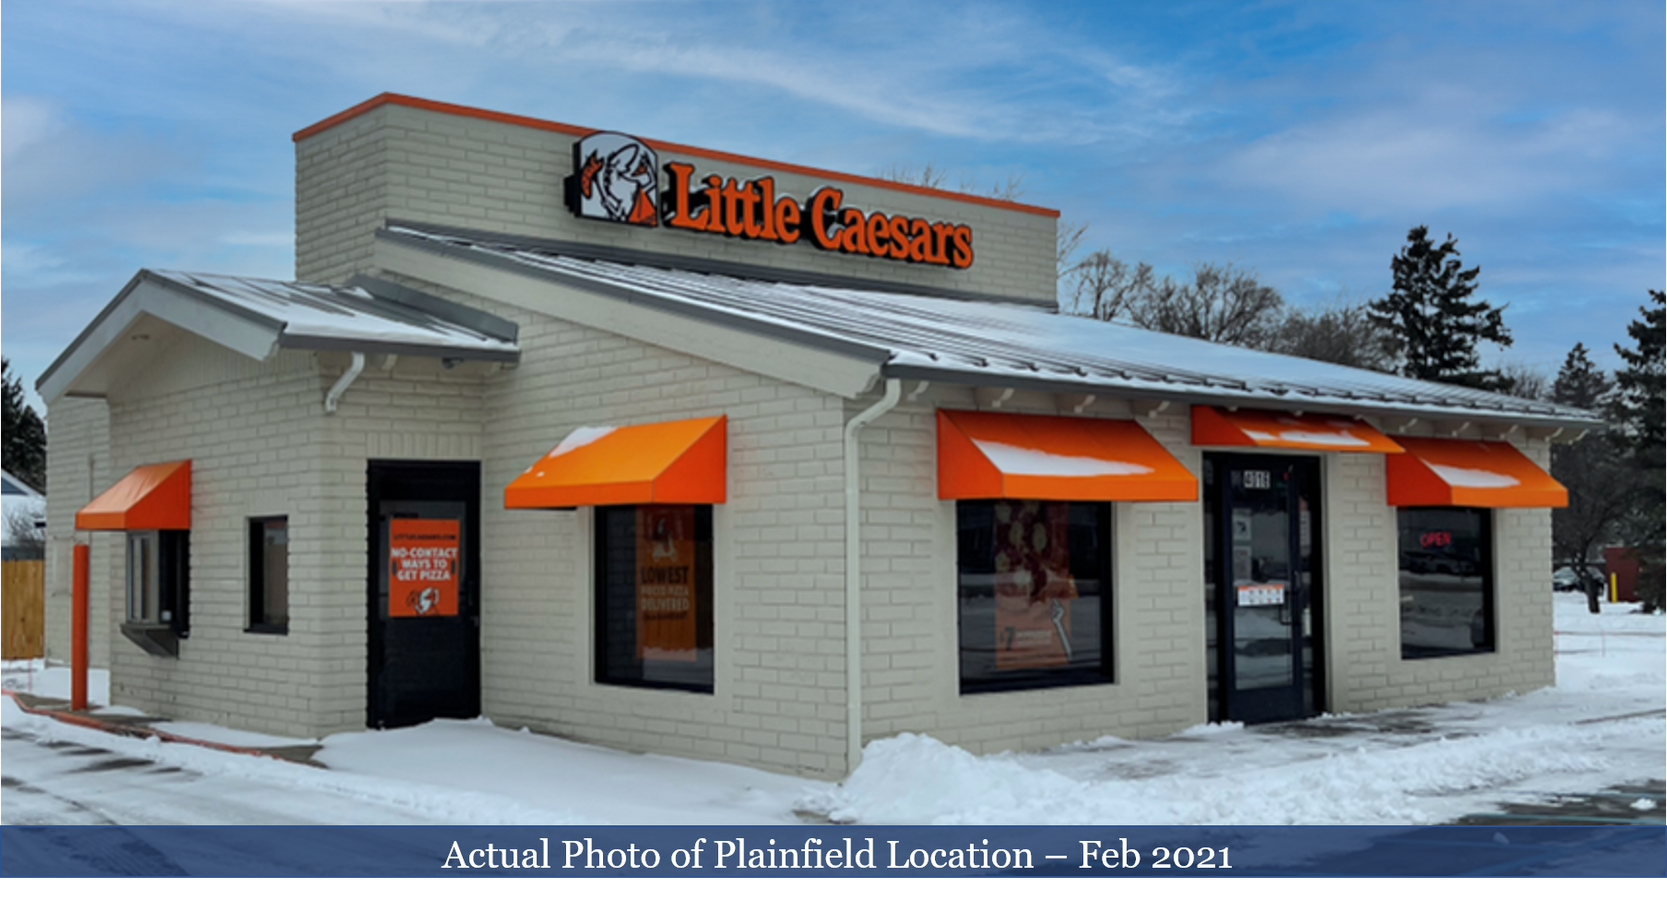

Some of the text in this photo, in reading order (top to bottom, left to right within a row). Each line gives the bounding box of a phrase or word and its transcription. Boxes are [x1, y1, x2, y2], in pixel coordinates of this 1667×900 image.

[671, 162, 972, 268] Little Caesars
[1420, 532, 1451, 547] OPEN
[391, 547, 458, 558] NO-CONTACT
[402, 559, 447, 569] WAYS TO
[397, 570, 451, 581] GET PIZZA
[641, 566, 689, 584] LOWEST
